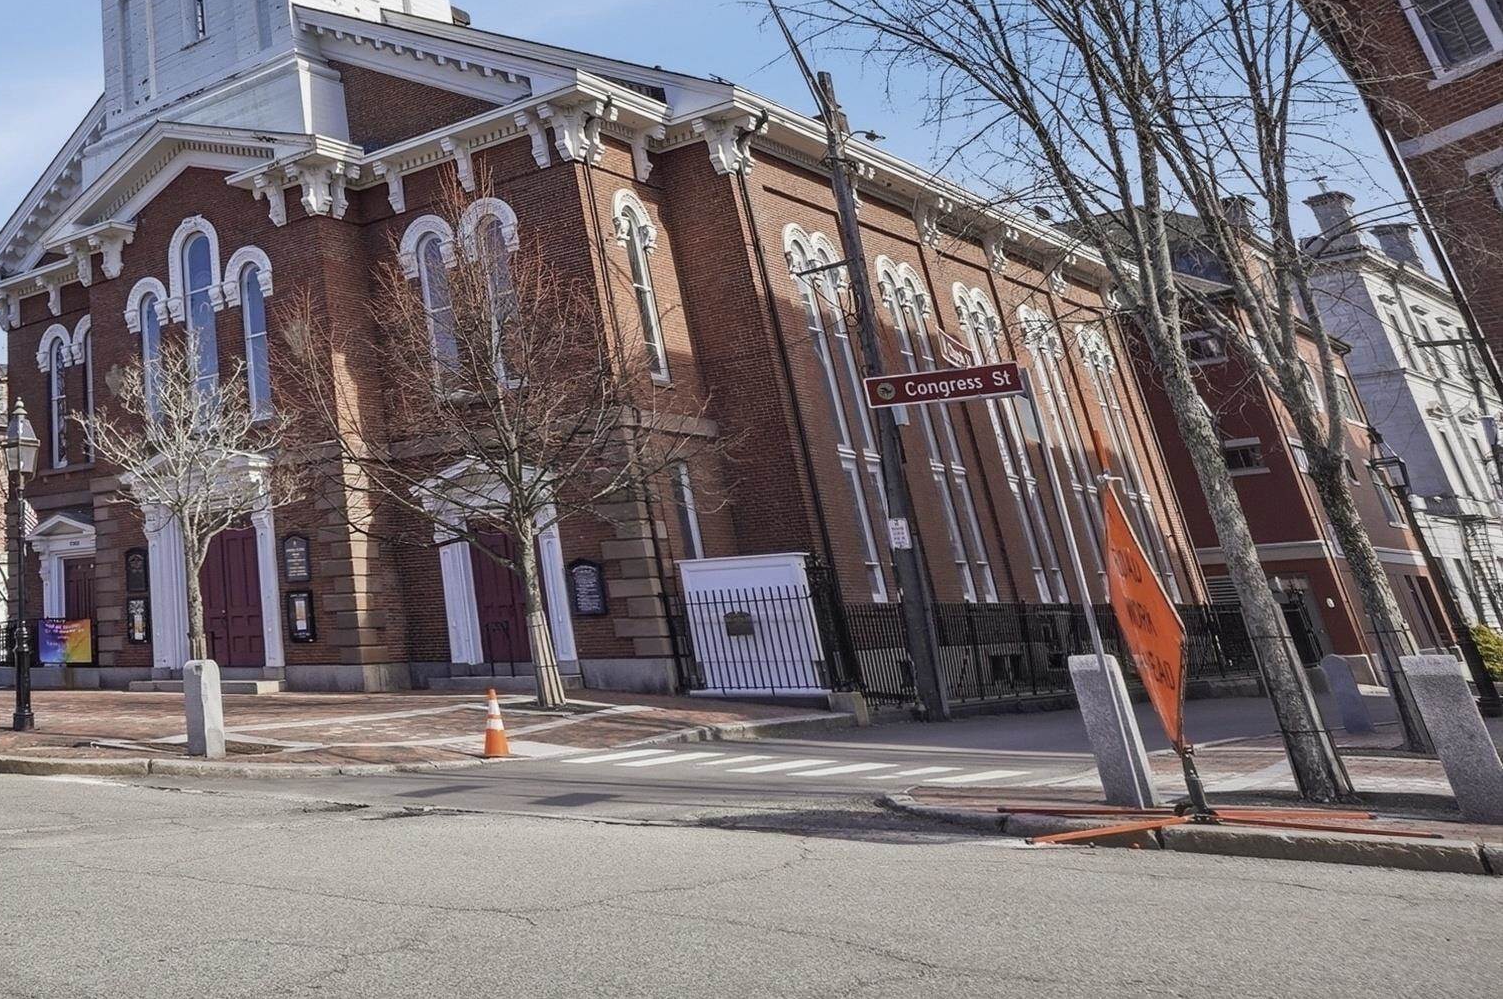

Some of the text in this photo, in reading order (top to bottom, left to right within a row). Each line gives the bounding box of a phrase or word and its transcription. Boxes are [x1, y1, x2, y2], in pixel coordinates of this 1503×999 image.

[904, 370, 1012, 397] Congress St
[1126, 599, 1157, 636] WORK
[1135, 650, 1176, 691] HEAD
